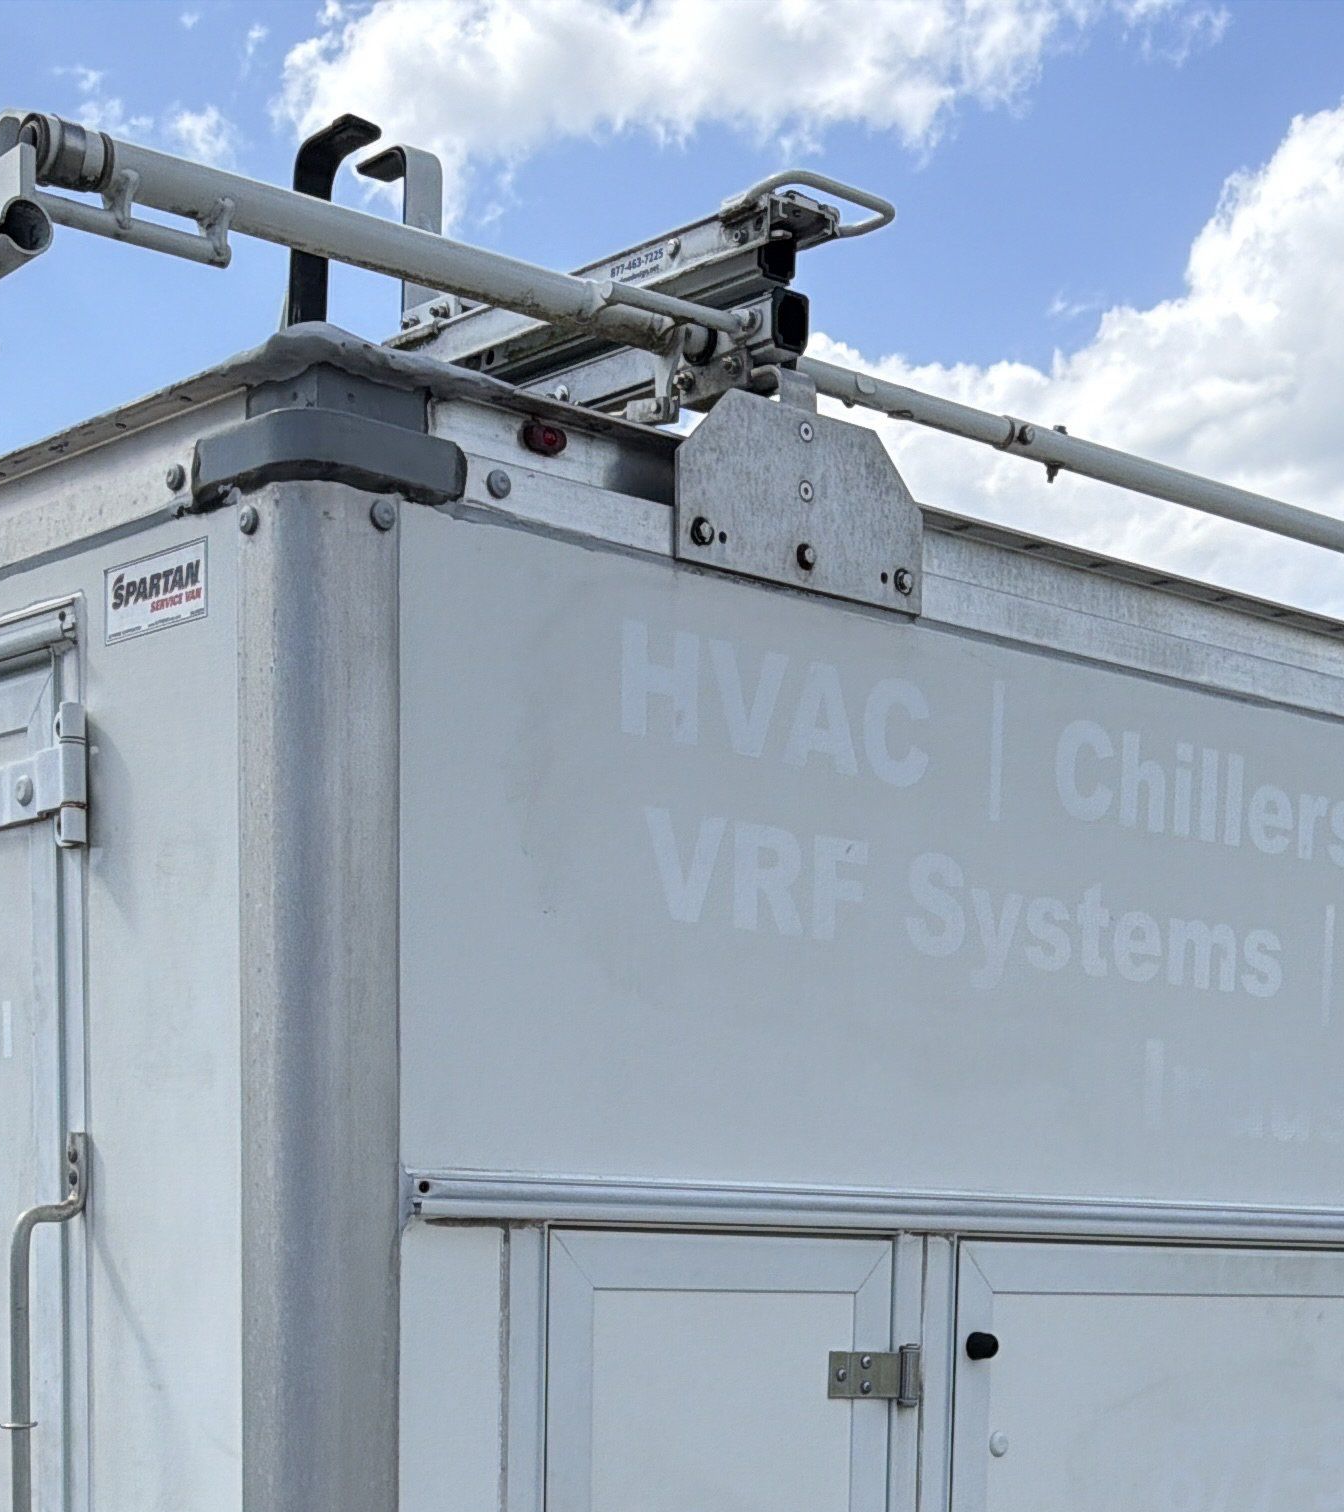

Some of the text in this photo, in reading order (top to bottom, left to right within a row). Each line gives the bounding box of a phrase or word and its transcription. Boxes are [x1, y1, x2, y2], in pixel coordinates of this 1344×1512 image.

[610, 248, 664, 278] 877-463-7225
[112, 559, 201, 610] SPARTAN
[150, 587, 203, 613] SERVICE VAN
[620, 618, 931, 789] HVAC
[646, 806, 869, 942] VRF
[905, 851, 1284, 999] Systems
